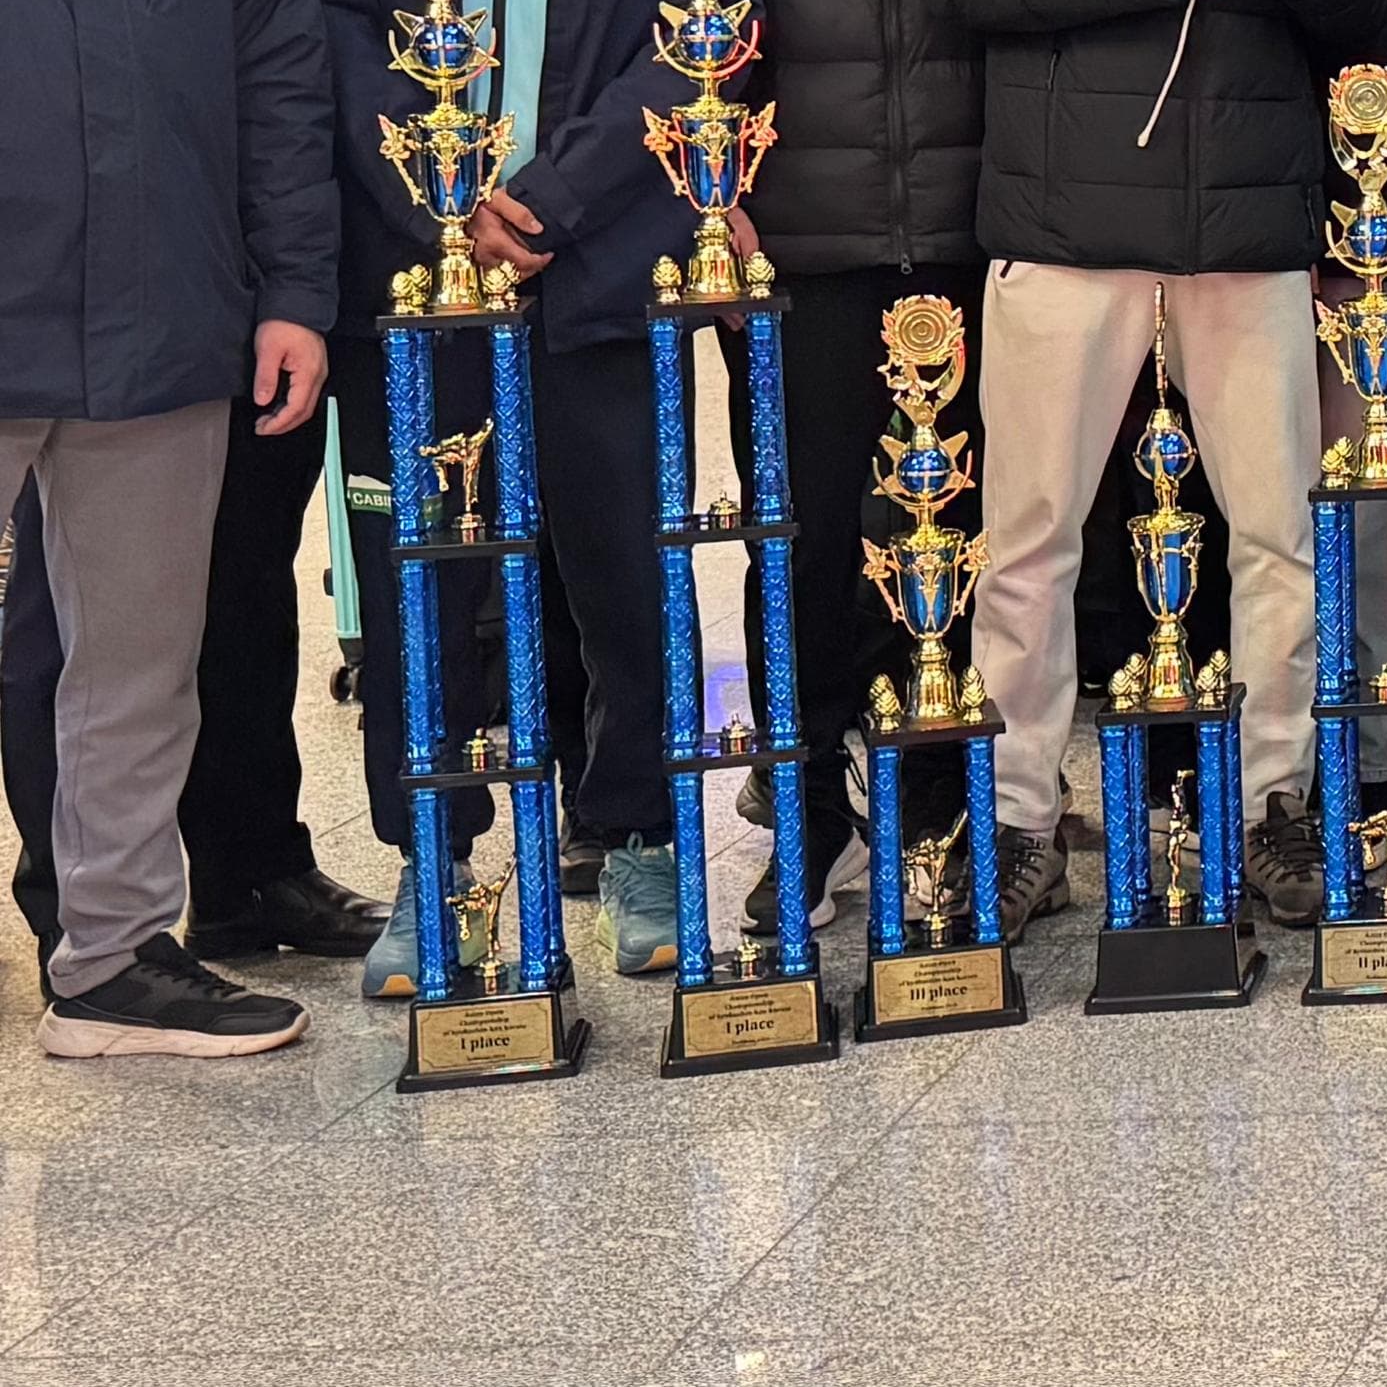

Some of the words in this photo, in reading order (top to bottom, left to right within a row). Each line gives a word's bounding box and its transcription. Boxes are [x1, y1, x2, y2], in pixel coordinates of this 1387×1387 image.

[1359, 957, 1368, 968] II
[910, 988, 925, 1000] III
[930, 986, 968, 1001] place
[726, 1022, 731, 1033] I
[735, 1020, 774, 1035] place
[461, 1038, 466, 1049] I
[470, 1036, 510, 1052] place
